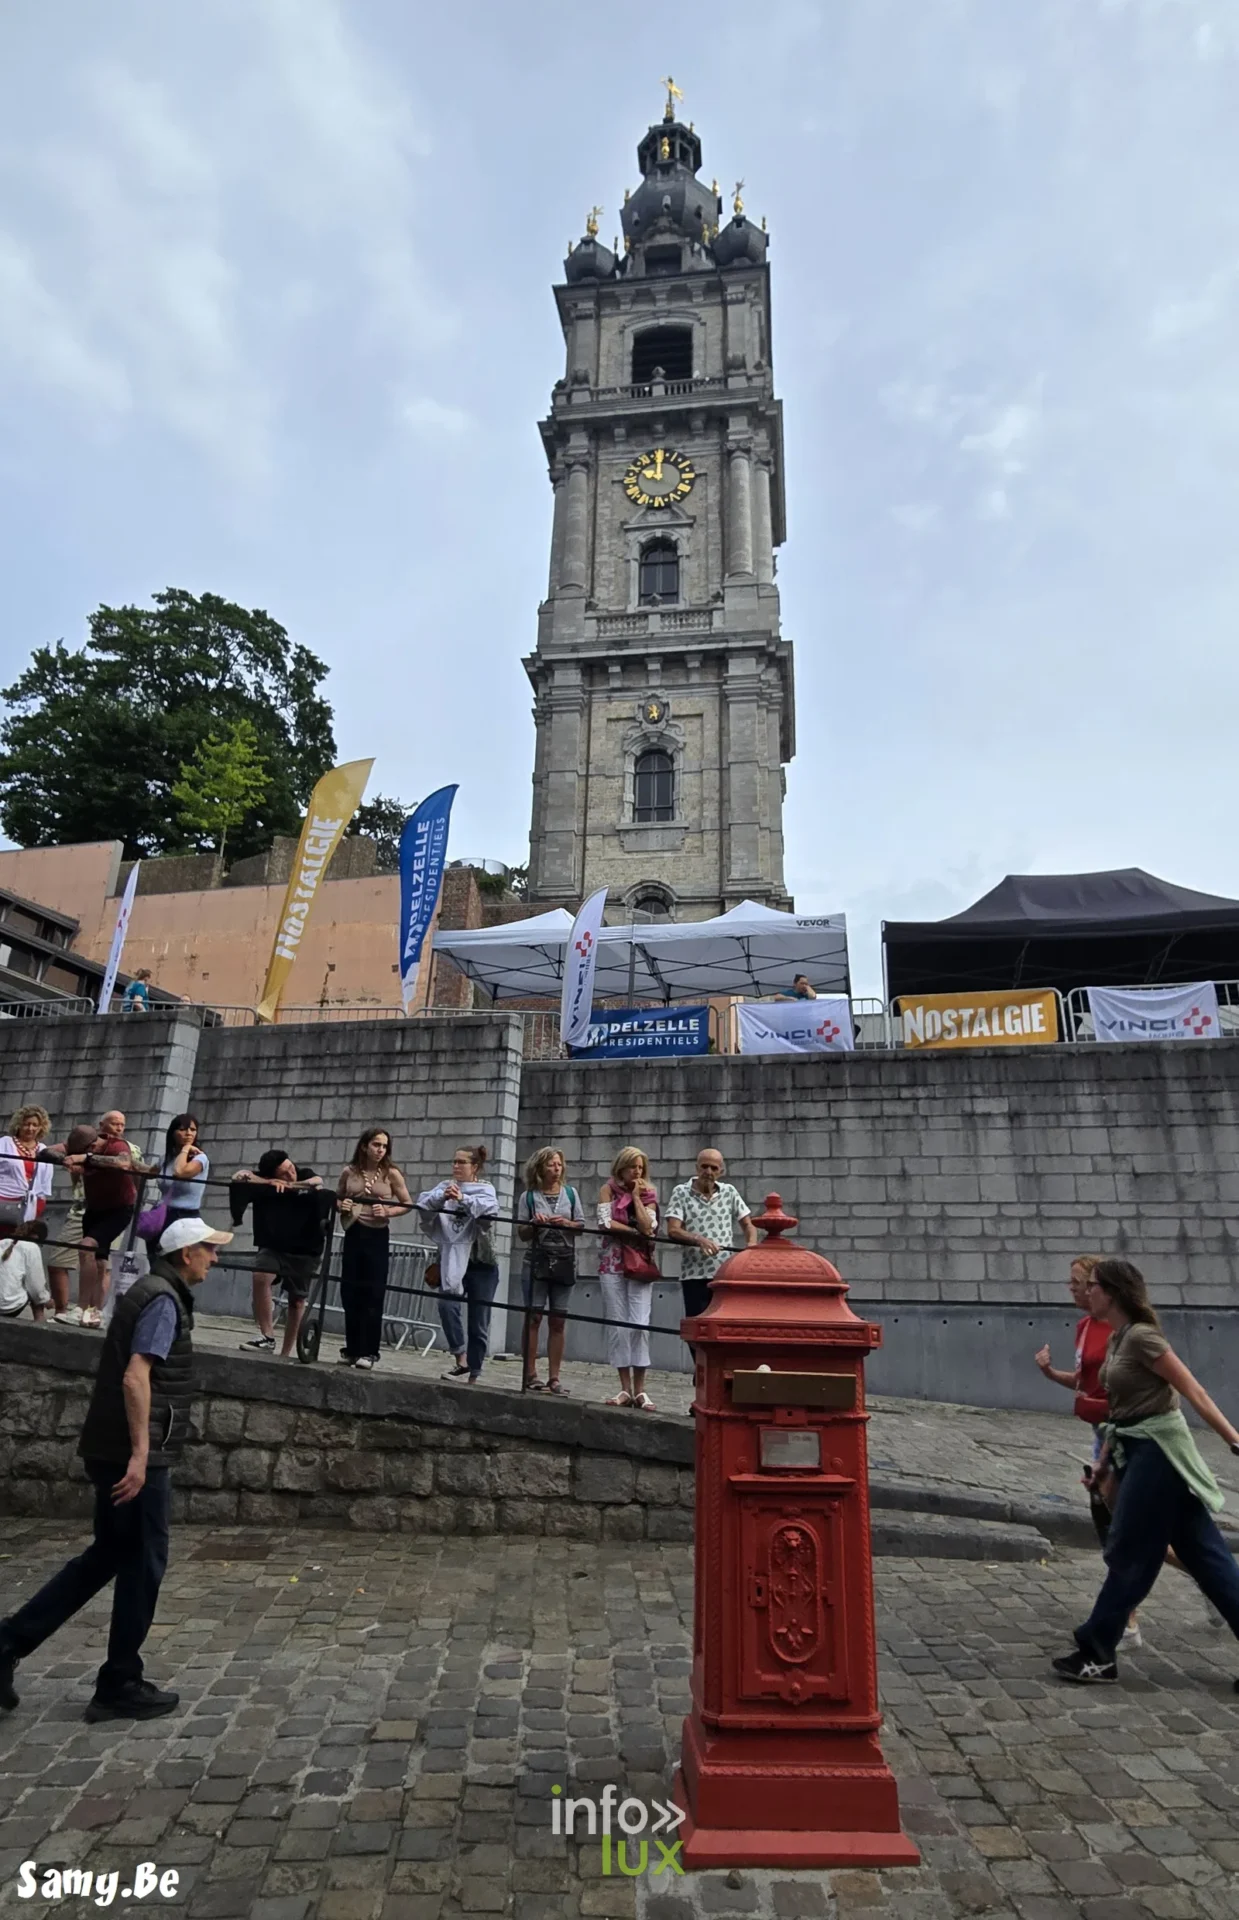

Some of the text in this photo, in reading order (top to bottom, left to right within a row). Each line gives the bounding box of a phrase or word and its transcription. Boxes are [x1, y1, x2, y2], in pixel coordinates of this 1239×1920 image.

[275, 815, 343, 961] NOSTALGIE
[796, 918, 830, 927] VEVOR
[609, 1018, 700, 1034] DELZELLE
[903, 1002, 1046, 1044] NOSTALGIE
[1100, 1018, 1177, 1032] VINCI
[755, 1028, 812, 1040] VINCI
[609, 1036, 699, 1047] RESIDENTIELS
